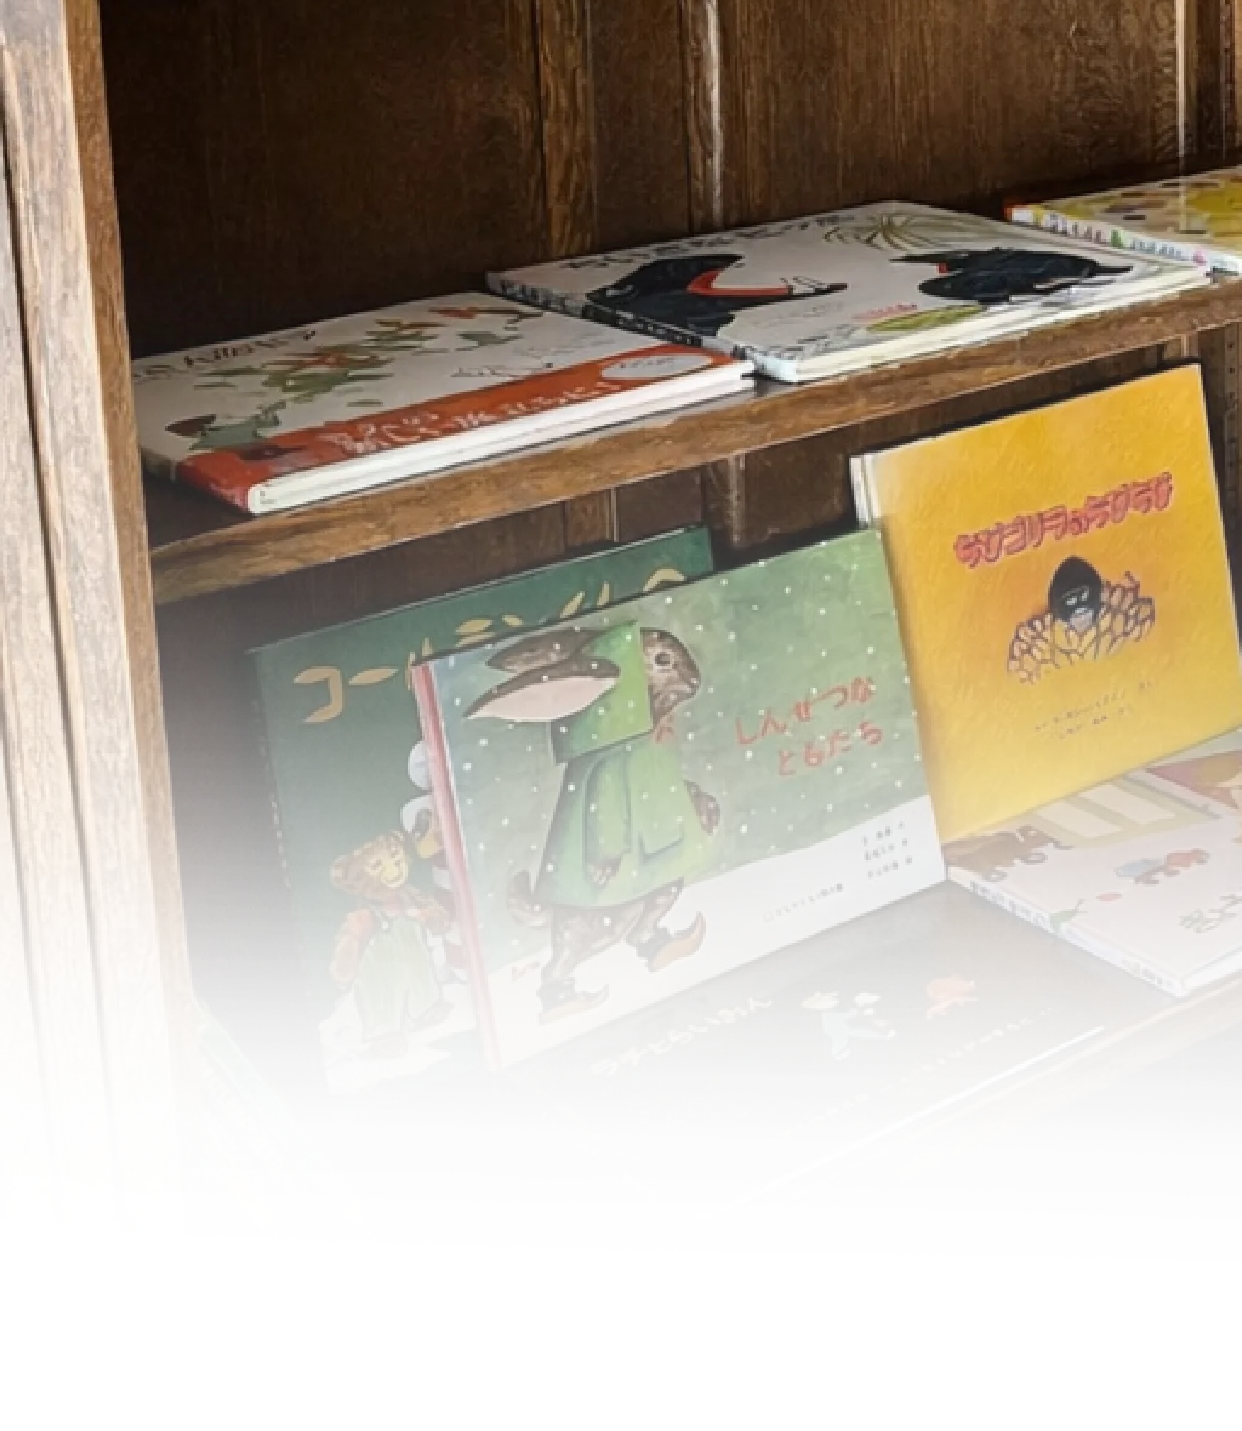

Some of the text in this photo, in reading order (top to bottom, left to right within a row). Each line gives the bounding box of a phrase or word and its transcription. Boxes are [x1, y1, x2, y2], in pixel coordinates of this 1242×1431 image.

[735, 676, 876, 745] しんせつな
